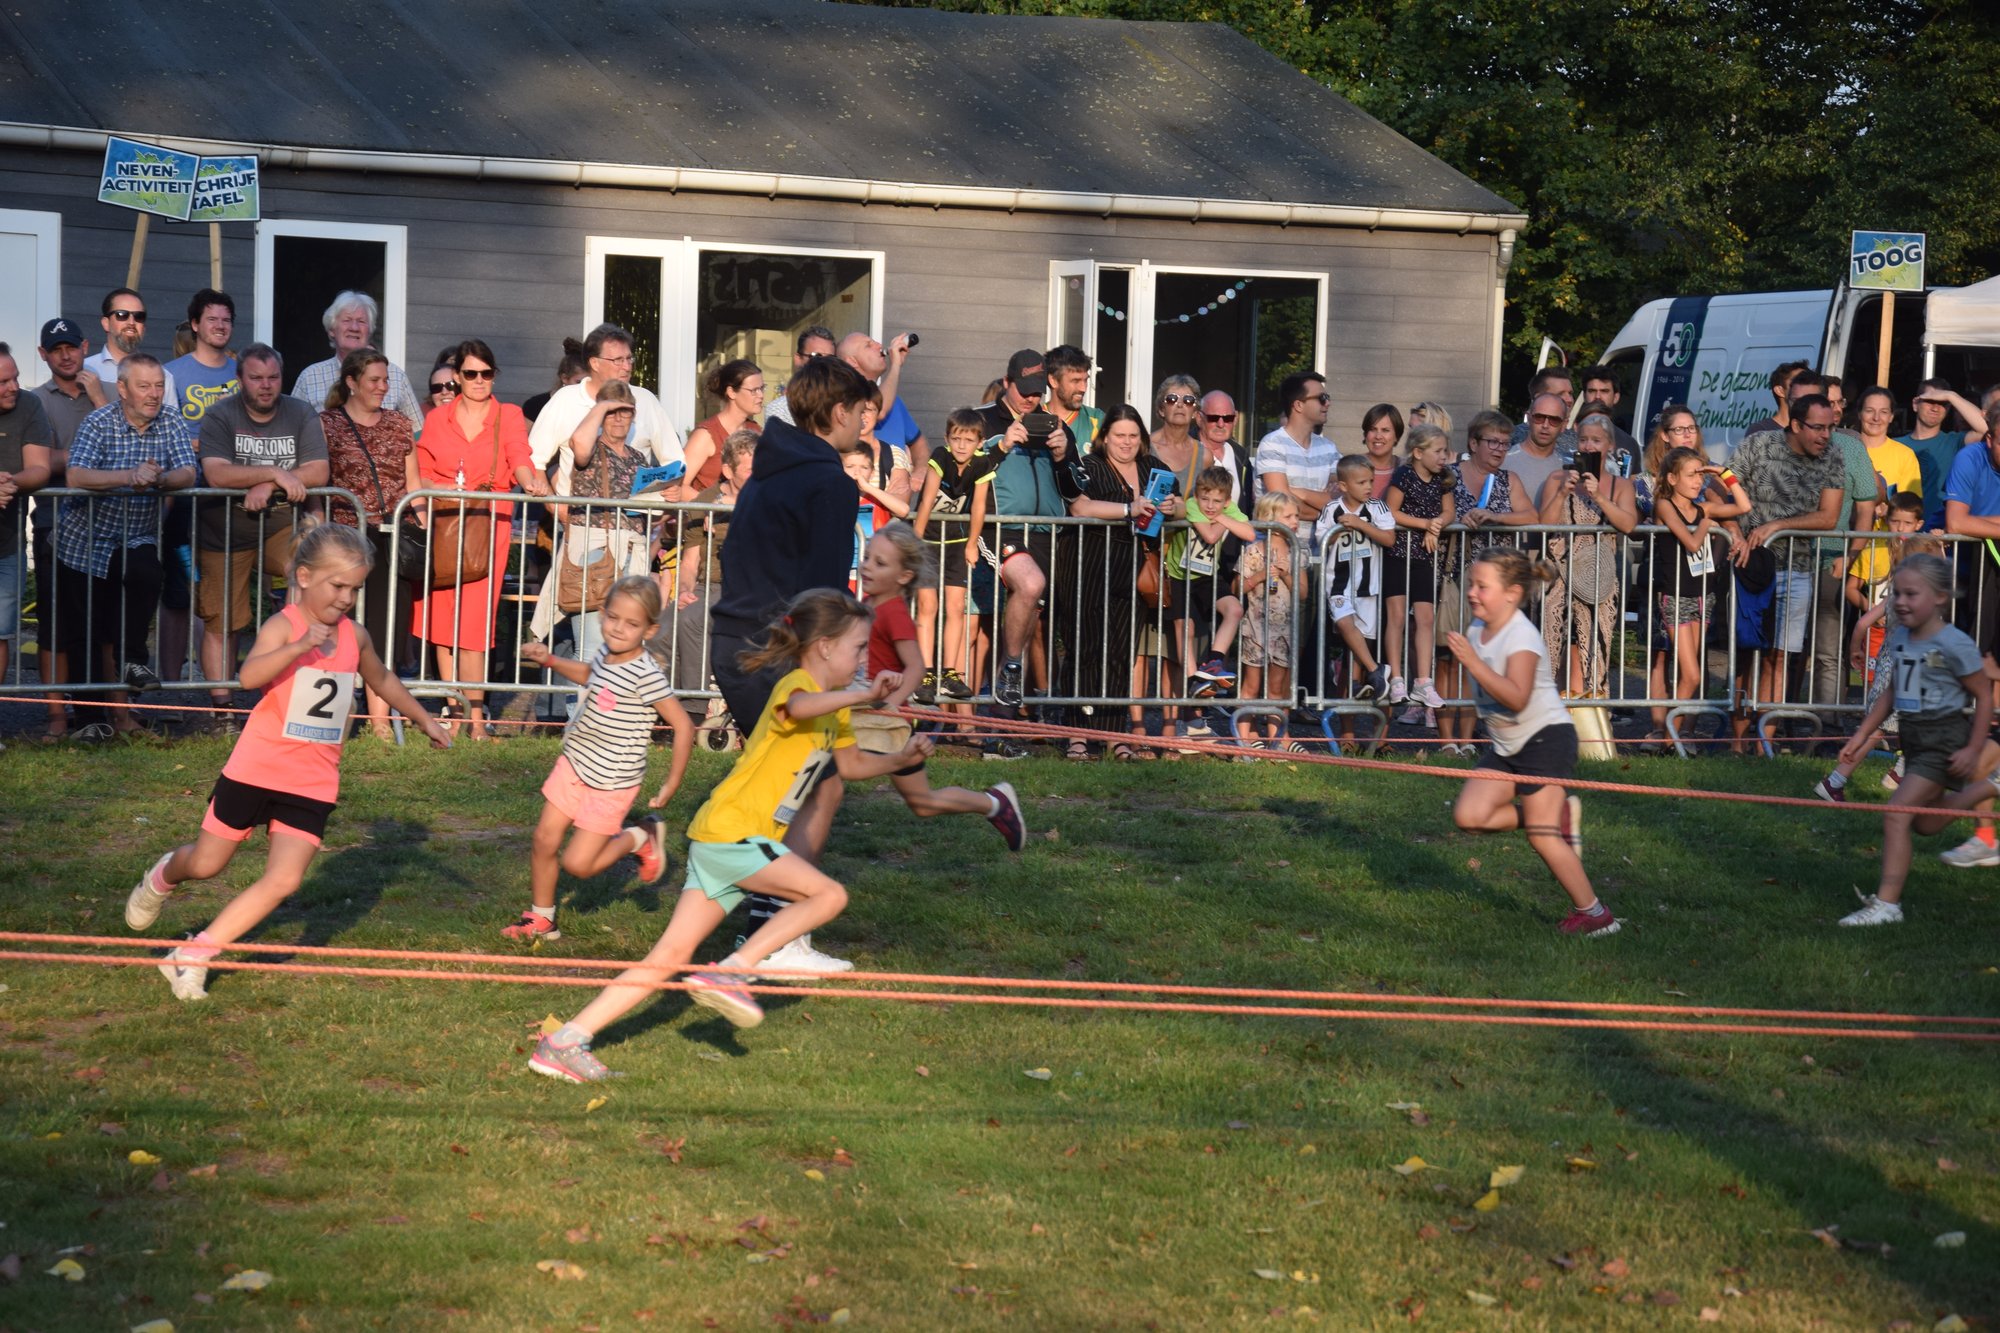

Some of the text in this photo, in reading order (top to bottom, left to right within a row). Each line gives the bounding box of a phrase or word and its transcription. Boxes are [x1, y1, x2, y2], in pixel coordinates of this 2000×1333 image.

[118, 163, 179, 177] NEVEN-
[102, 179, 192, 194] ACTIVITEIT
[1853, 244, 1922, 273] TOOG
[1663, 322, 1695, 368] 50
[1699, 370, 1720, 393] De
[306, 677, 338, 719] 2
[794, 760, 820, 800] 1
